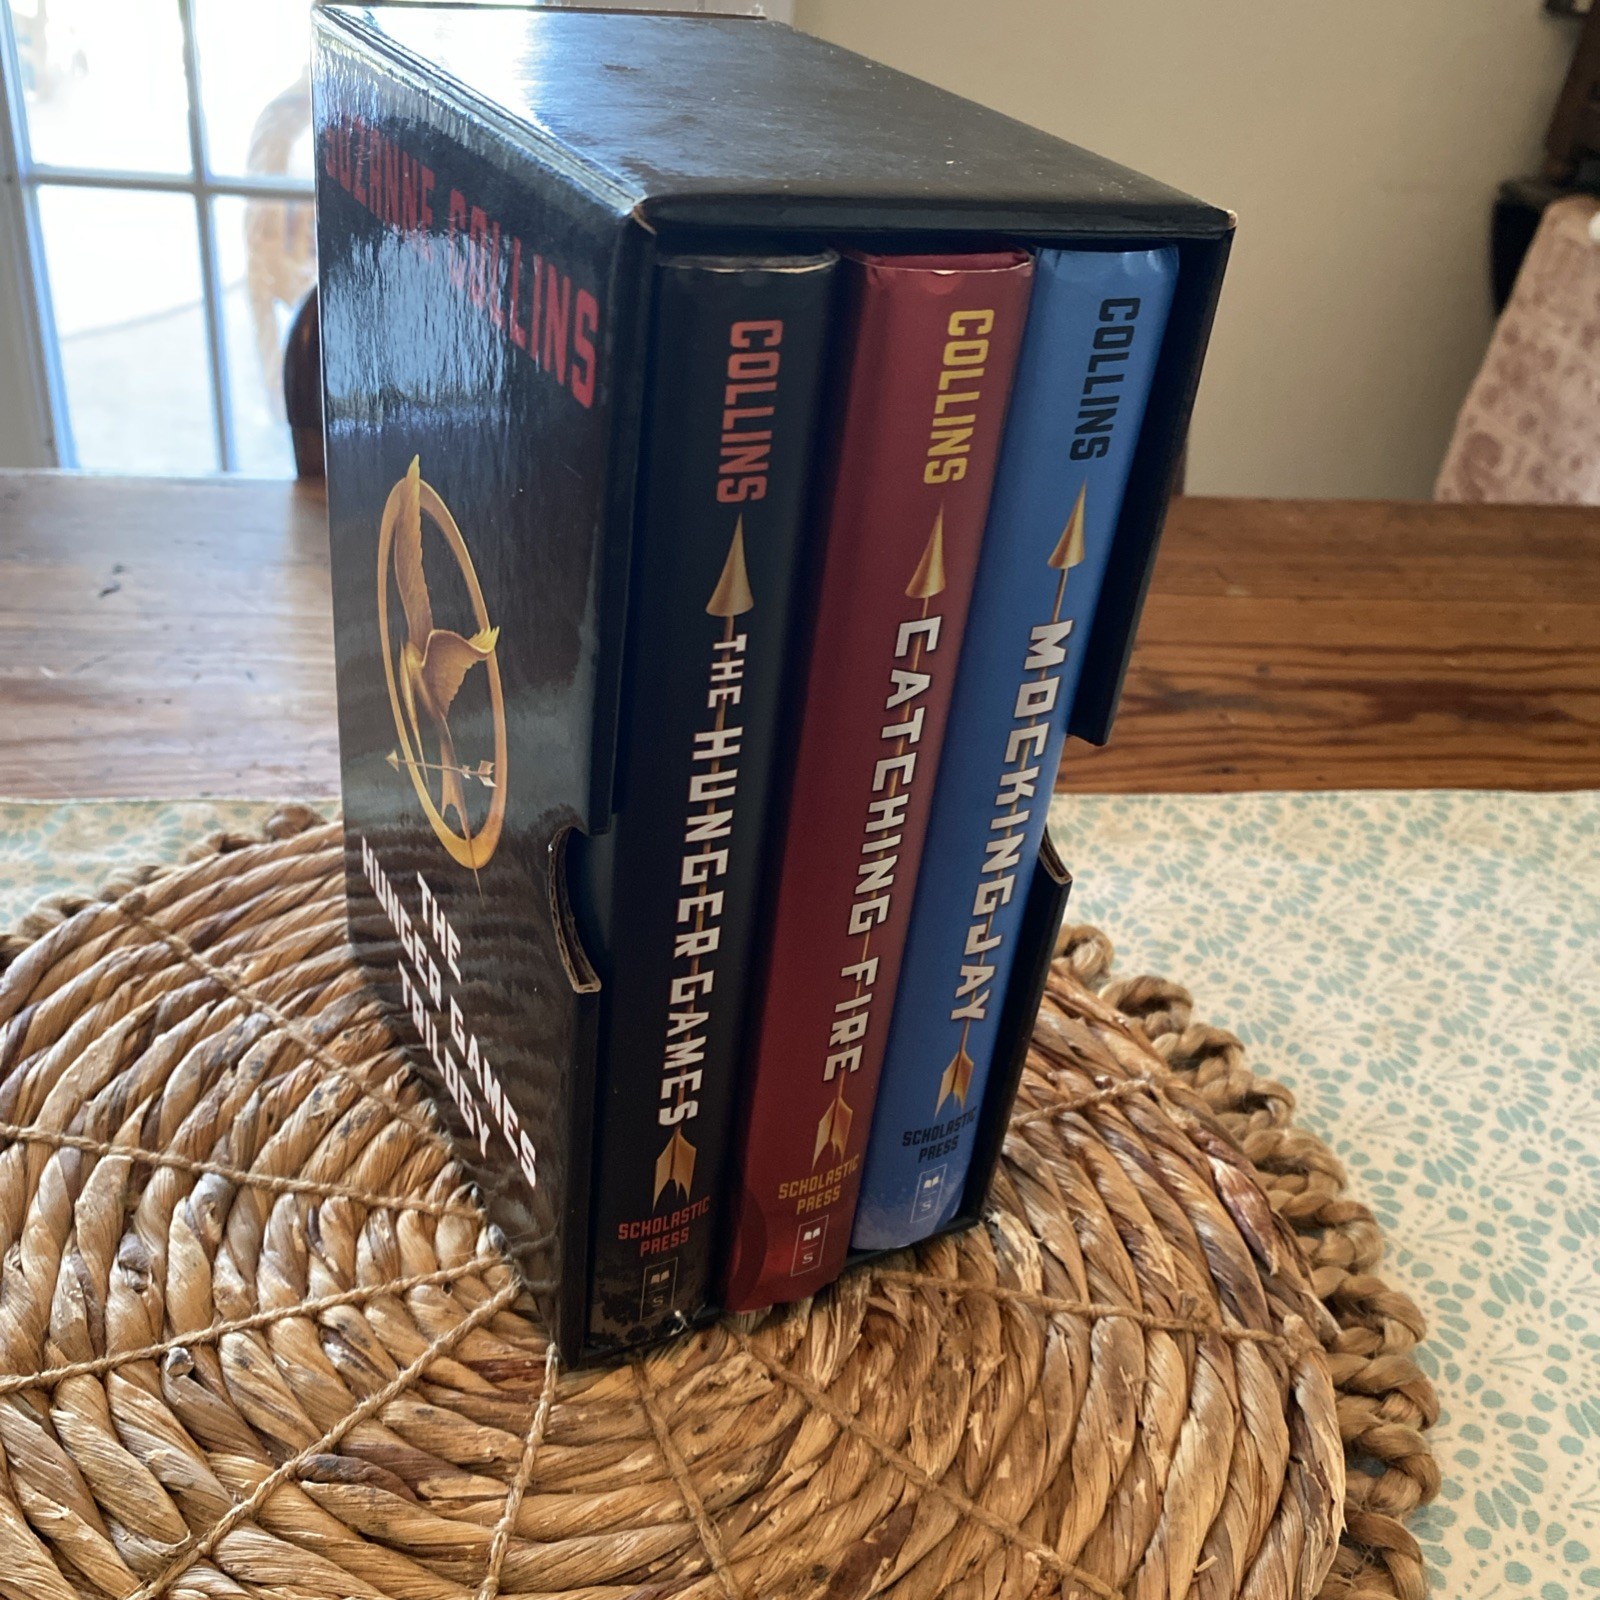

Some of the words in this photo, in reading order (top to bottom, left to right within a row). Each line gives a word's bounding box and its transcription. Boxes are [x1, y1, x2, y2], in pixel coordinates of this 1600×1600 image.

[449, 187, 599, 409] COLLINS
[716, 319, 783, 503] COLLINS
[923, 309, 994, 484] COLLINS
[1069, 297, 1141, 461] COLLINS
[707, 634, 747, 708] THE
[674, 727, 742, 959] HUNGER
[847, 616, 941, 936] CATCHING
[951, 620, 1073, 1021] MOCKINGJAY
[417, 871, 461, 984] THE
[362, 836, 441, 1011] HUNGER
[450, 995, 536, 1189] GAMES
[398, 960, 490, 1158] TRILOGY
[658, 970, 714, 1126] GAMES
[823, 956, 879, 1082] FIRE
[778, 1153, 860, 1200] SCHOLASTIC
[796, 1184, 841, 1215] PRESS
[902, 1105, 978, 1147] SCHOLASTIC
[918, 1135, 959, 1163] PRESS
[618, 1195, 711, 1240] SCHOLASTIC
[641, 1226, 690, 1257] PRESS
